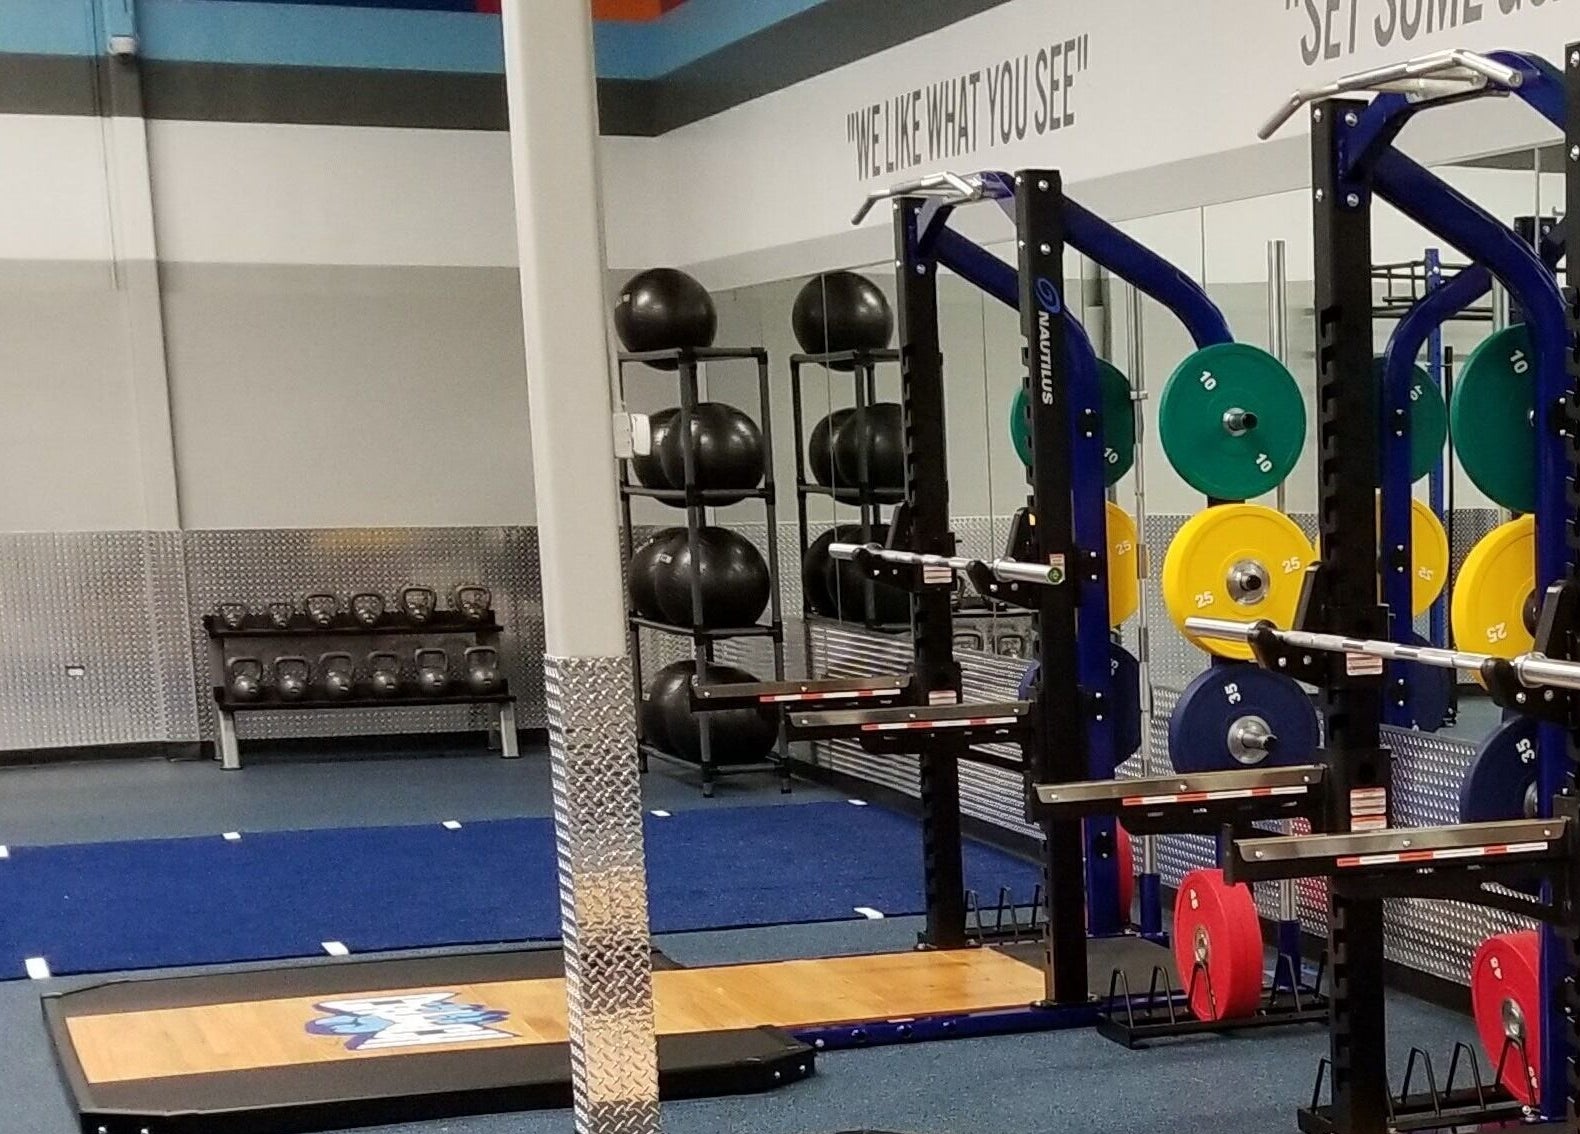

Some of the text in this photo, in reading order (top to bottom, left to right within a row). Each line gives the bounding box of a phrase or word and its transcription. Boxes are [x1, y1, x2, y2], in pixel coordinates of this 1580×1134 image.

[847, 33, 1089, 181] "WE LIKE WHAT YOU SEE"
[1037, 309, 1054, 406] NAUTILUS
[1510, 349, 1529, 374] 10
[1199, 370, 1217, 391] 10
[1103, 447, 1119, 464] 10
[1255, 453, 1273, 473] 10
[1115, 539, 1132, 556] 25
[1281, 556, 1301, 574] 25
[1194, 590, 1214, 608] 25
[1486, 622, 1507, 643] 25
[1224, 682, 1241, 705] 35
[1515, 738, 1536, 764] 35
